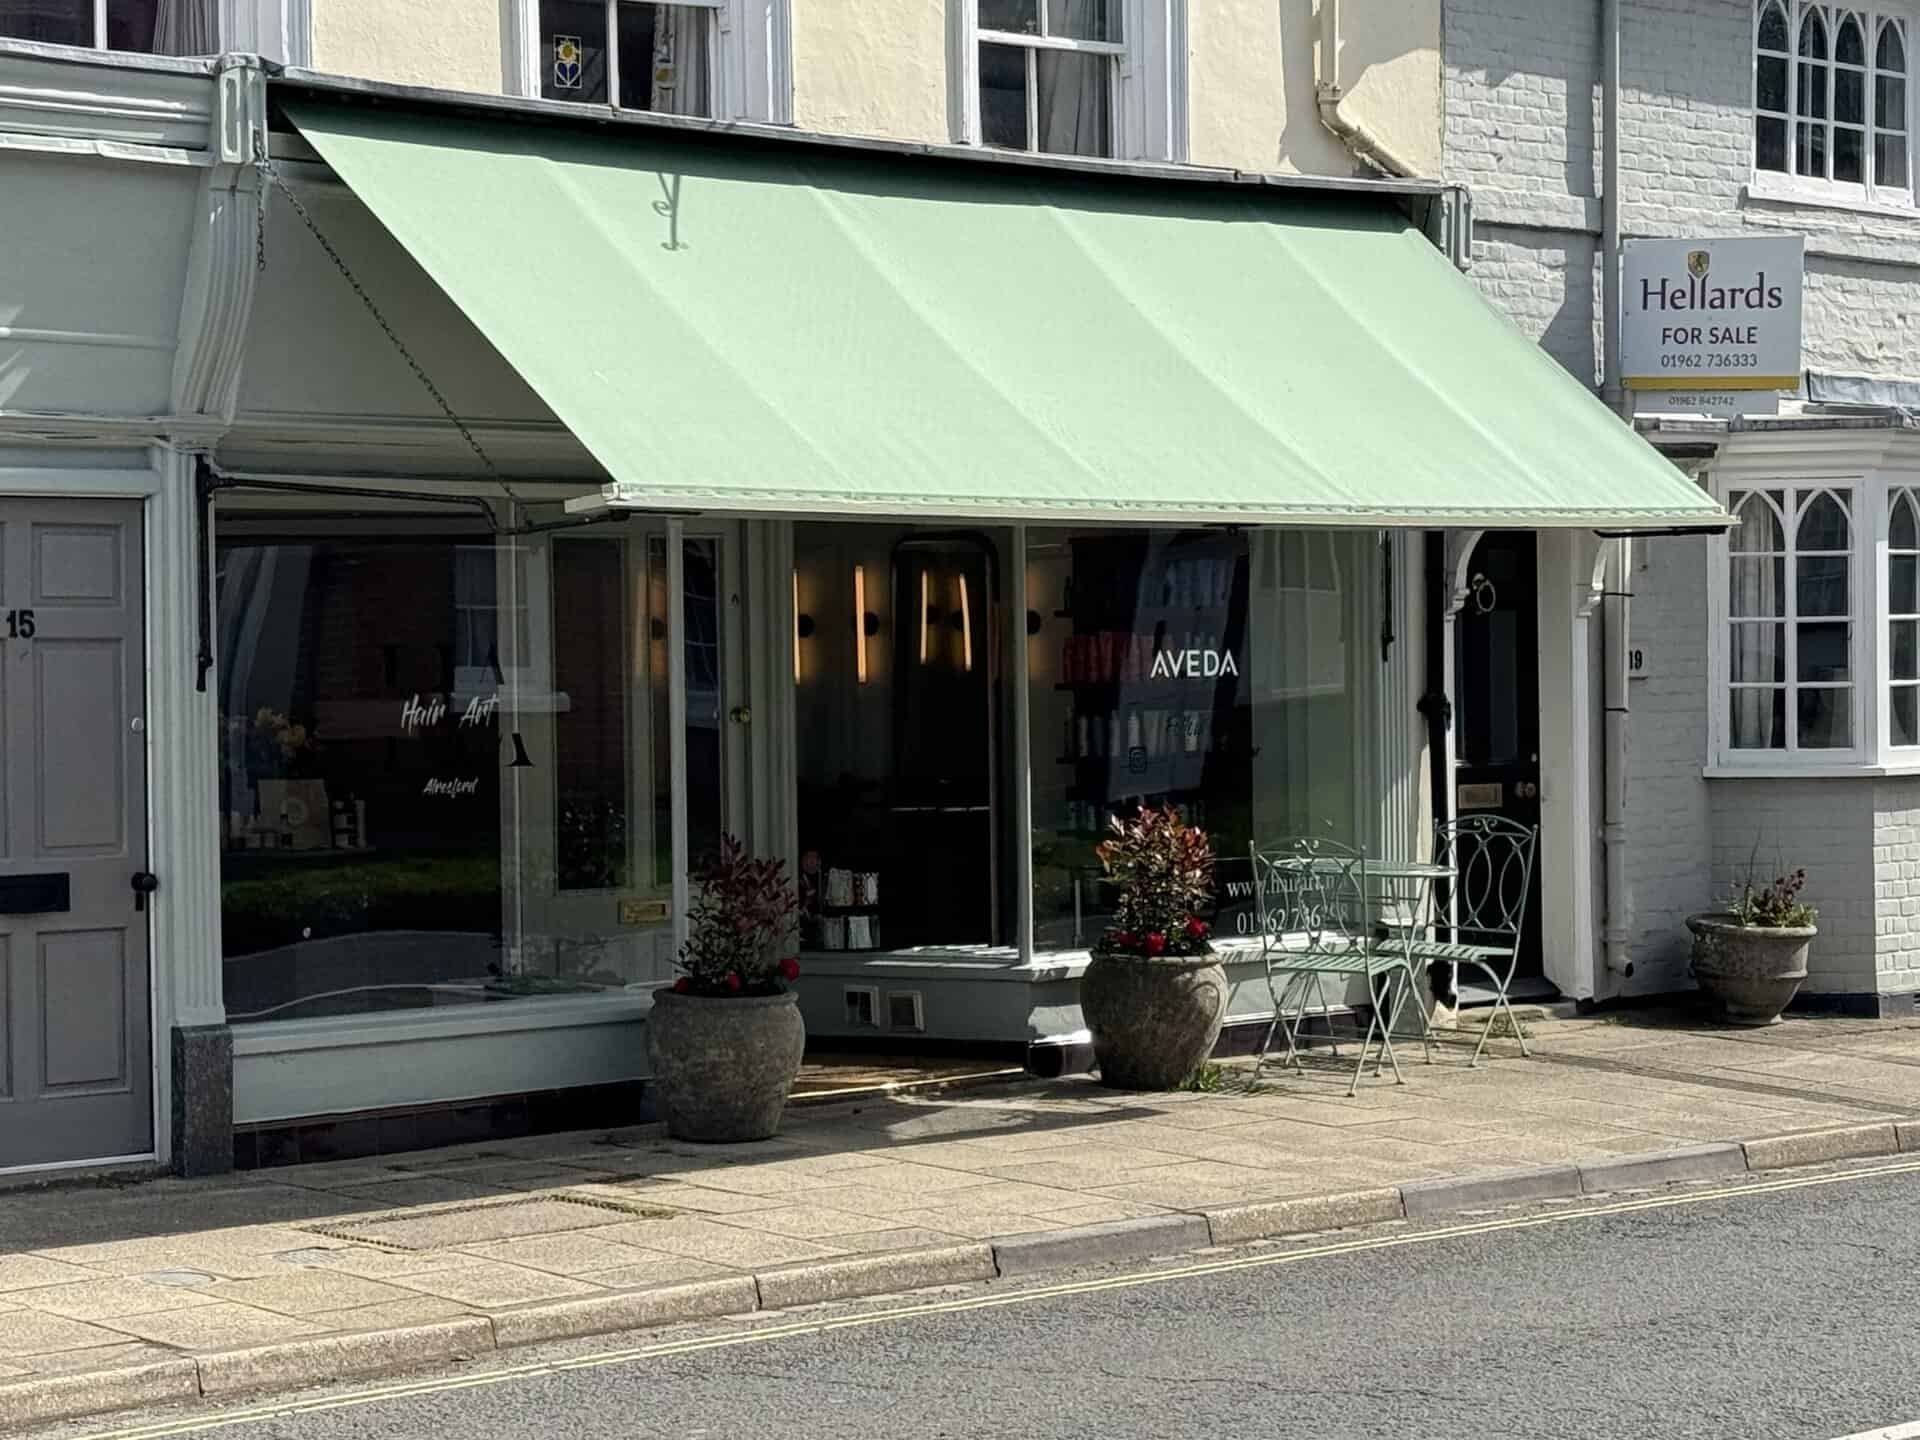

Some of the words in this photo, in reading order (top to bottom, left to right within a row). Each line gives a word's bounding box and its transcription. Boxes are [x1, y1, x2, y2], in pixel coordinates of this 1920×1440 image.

[1640, 271, 1783, 311] Hellards
[1661, 327, 1703, 345] FOR
[1709, 326, 1758, 345] SALE
[1661, 354, 1701, 368] 01962
[1707, 353, 1758, 368] 736333
[6, 609, 35, 638] 15
[1150, 649, 1239, 679] AVEDA
[1629, 650, 1643, 670] 19
[401, 693, 446, 735] Hair
[458, 693, 500, 729] Art
